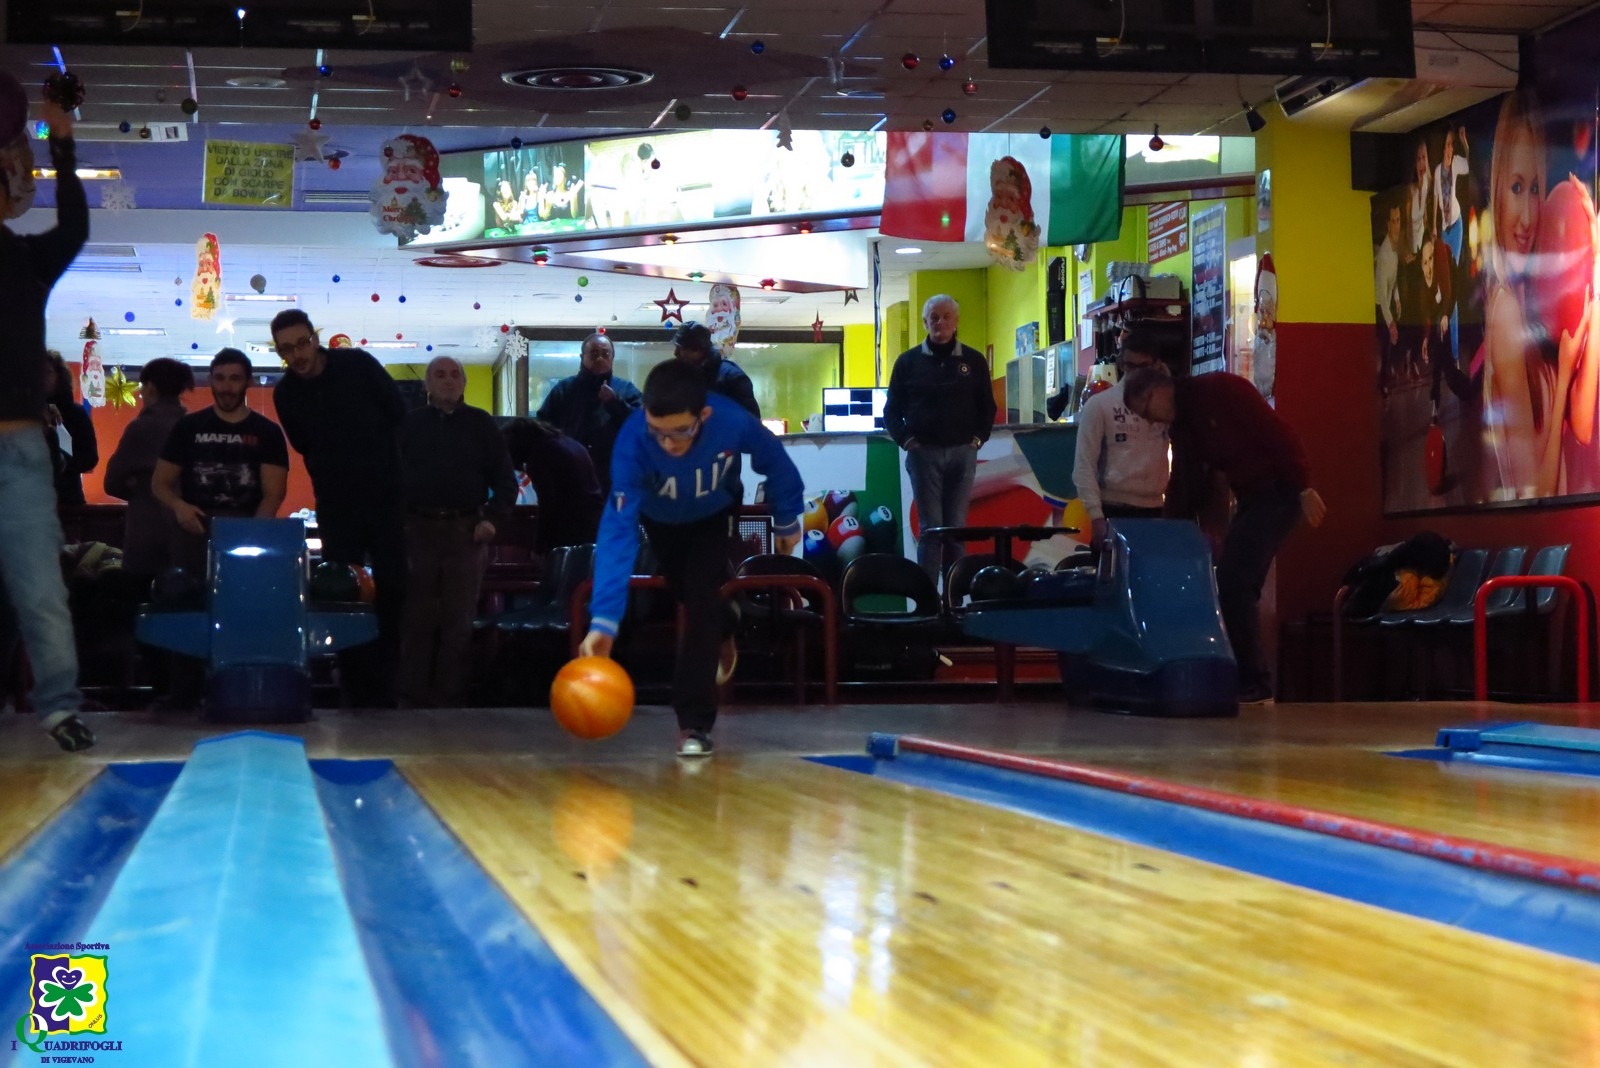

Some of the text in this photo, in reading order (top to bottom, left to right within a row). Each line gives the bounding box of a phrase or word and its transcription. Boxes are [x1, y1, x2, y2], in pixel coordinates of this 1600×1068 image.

[207, 144, 294, 160] VIETATO USCIRE
[216, 156, 284, 168] DALLA ZONA
[224, 167, 274, 178] DI GIOCO
[213, 177, 285, 189] CON SCARPE
[846, 518, 857, 527] 11
